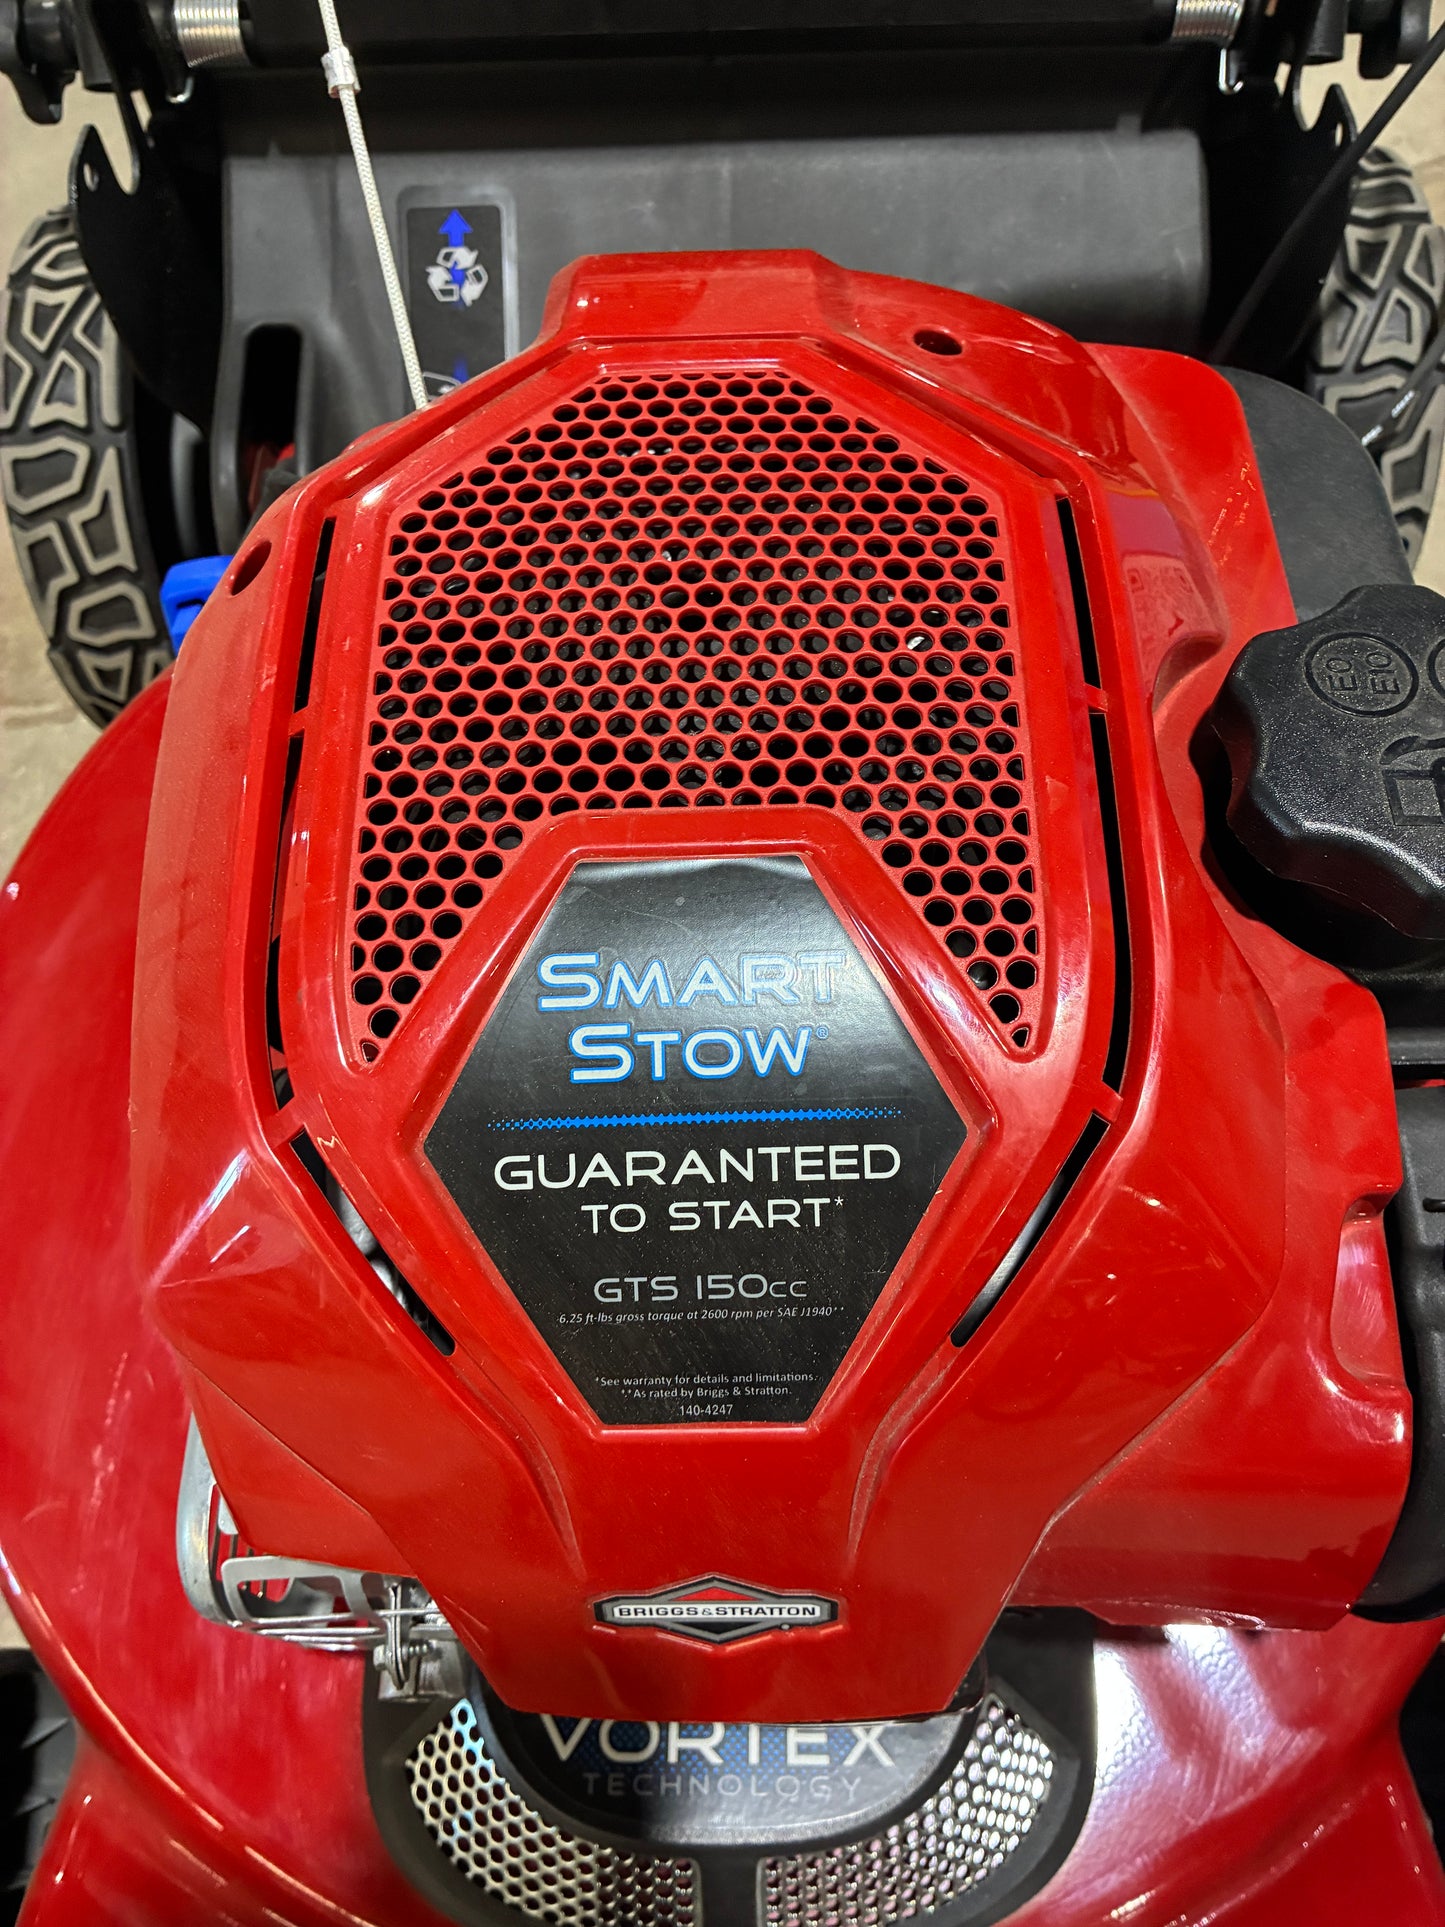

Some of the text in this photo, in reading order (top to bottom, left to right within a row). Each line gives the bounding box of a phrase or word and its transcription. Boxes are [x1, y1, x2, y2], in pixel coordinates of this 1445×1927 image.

[538, 951, 847, 1012] SMART
[494, 1143, 901, 1191] GUARANTEED
[581, 1203, 646, 1234] TO
[594, 1275, 679, 1302] GTS
[559, 1313, 583, 1324] 6.25
[585, 1312, 613, 1325] ft-lbs
[616, 1313, 644, 1324] gross
[648, 1311, 683, 1322] torque
[687, 1310, 698, 1320] at
[701, 1309, 728, 1319] 2600
[731, 1310, 753, 1320] rpm
[756, 1309, 774, 1320] per
[777, 1307, 798, 1317] SAE
[623, 1376, 672, 1386] warranty
[675, 1374, 690, 1384] for
[694, 1373, 729, 1384] details
[732, 1373, 752, 1383] and
[755, 1372, 817, 1383] limitations.
[649, 1388, 677, 1398] rated
[680, 1388, 693, 1398] by
[697, 1386, 729, 1399] Briggs
[733, 1386, 741, 1396] &
[744, 1386, 792, 1396] Stratton.
[680, 1404, 733, 1416] 140-4247
[619, 1605, 816, 1617] BRIGGS&STRATTON
[583, 1773, 861, 1798] TECHNOLOGY
